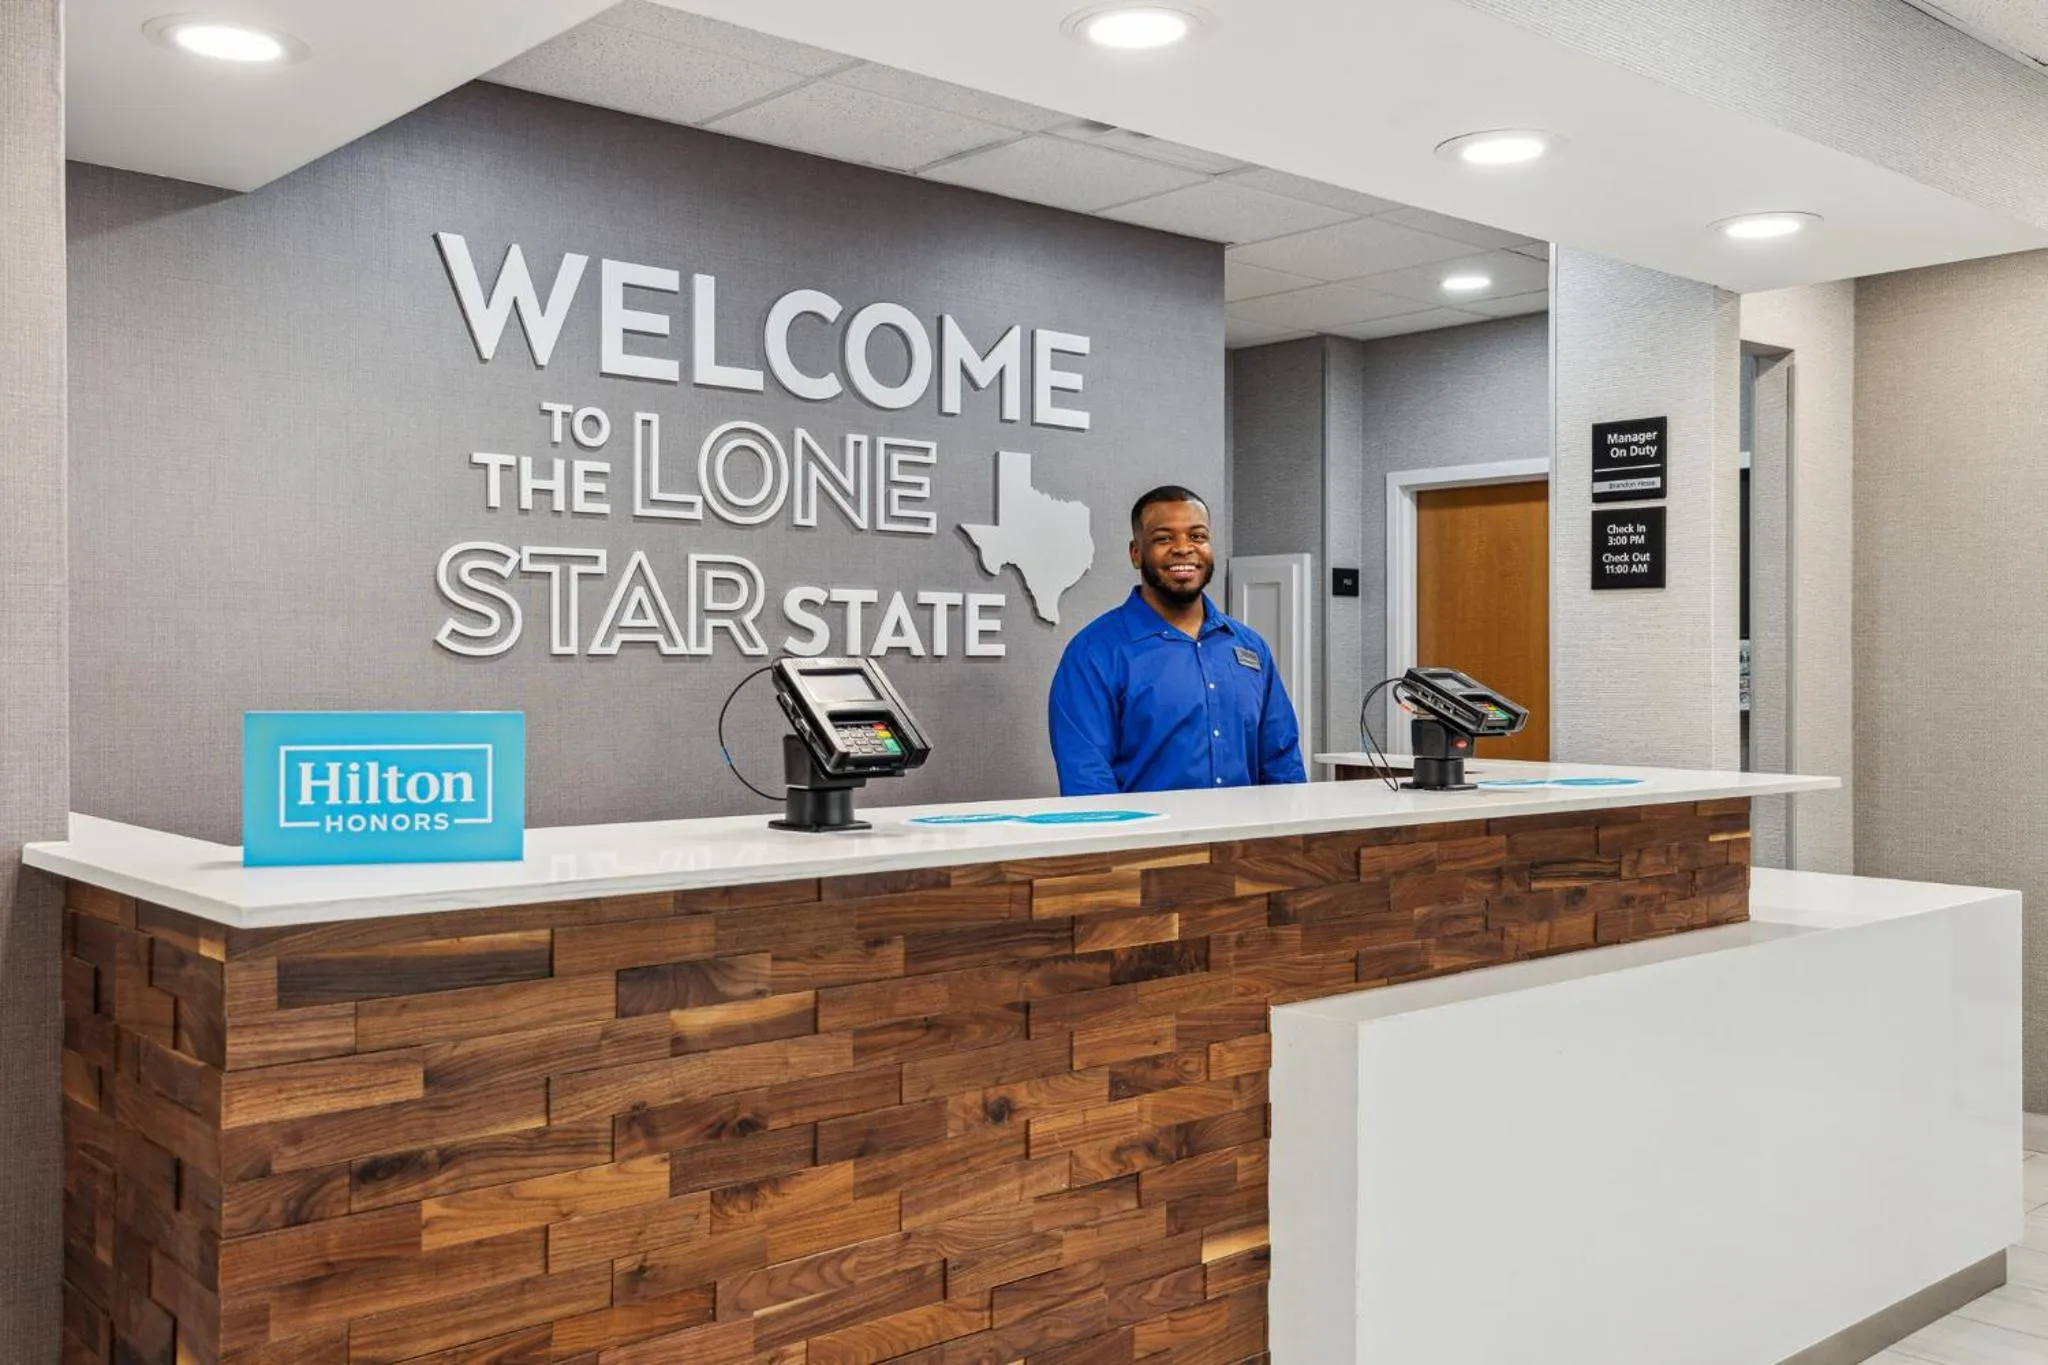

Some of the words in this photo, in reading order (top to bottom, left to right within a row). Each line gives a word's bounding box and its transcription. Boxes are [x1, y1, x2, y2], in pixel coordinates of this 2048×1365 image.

[433, 231, 1091, 430] WELCOME
[540, 401, 611, 447] TO
[1607, 431, 1658, 444] Manager
[1610, 447, 1627, 458] On
[1630, 445, 1657, 458] Duty
[470, 452, 611, 514] THE
[633, 412, 938, 534] LONE
[1606, 523, 1634, 535] Check
[1636, 523, 1646, 533] In
[1607, 535, 1628, 546] 3:00
[1630, 534, 1645, 545] PM
[1602, 552, 1630, 563] Check
[1632, 552, 1650, 562] Out
[1605, 564, 1629, 574] 11:00
[1630, 563, 1648, 574] AM
[435, 541, 769, 656] STAR
[782, 586, 1006, 657] STATE
[297, 761, 476, 806] Hilton
[325, 812, 450, 833] HONORS
